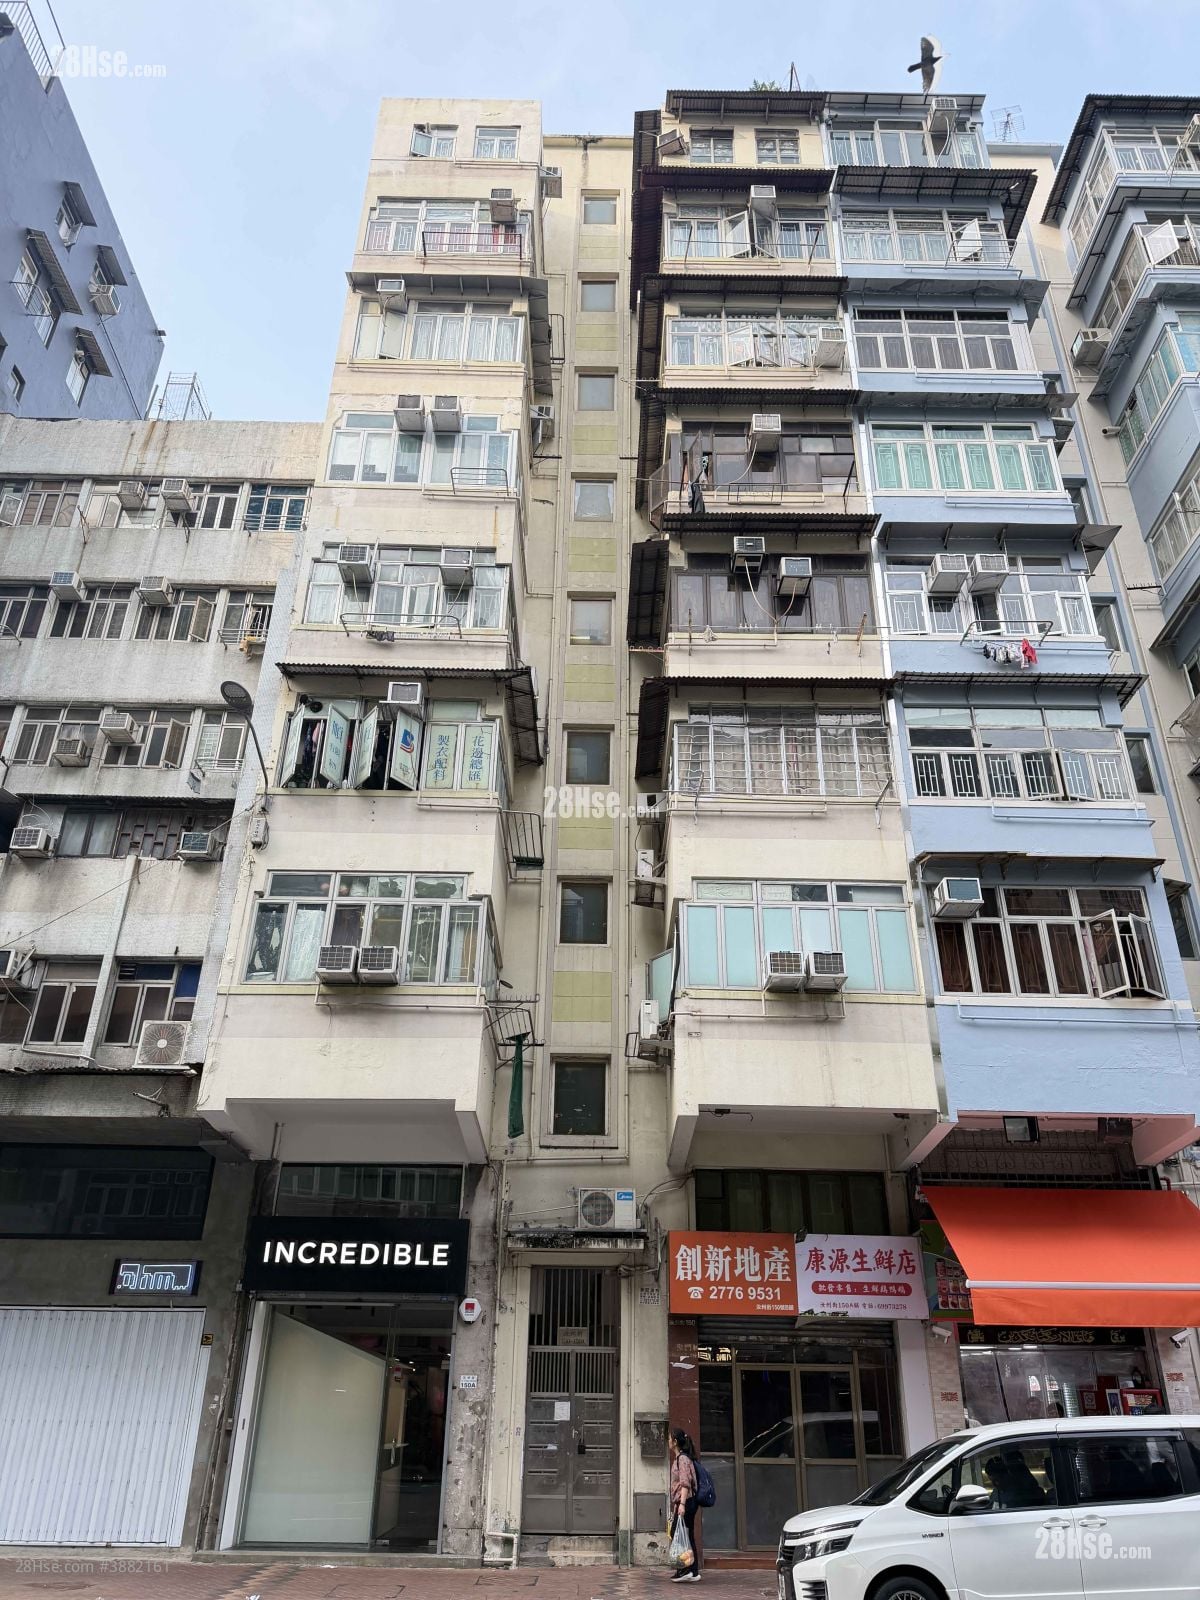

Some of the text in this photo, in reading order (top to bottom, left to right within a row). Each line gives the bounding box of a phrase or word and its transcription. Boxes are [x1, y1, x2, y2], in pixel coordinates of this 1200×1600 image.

[263, 1241, 450, 1267] INCREDIBLE
[674, 1243, 792, 1283] 創新地產
[804, 1247, 917, 1276] 康源生鮮店
[709, 1285, 781, 1301] 2776 9531
